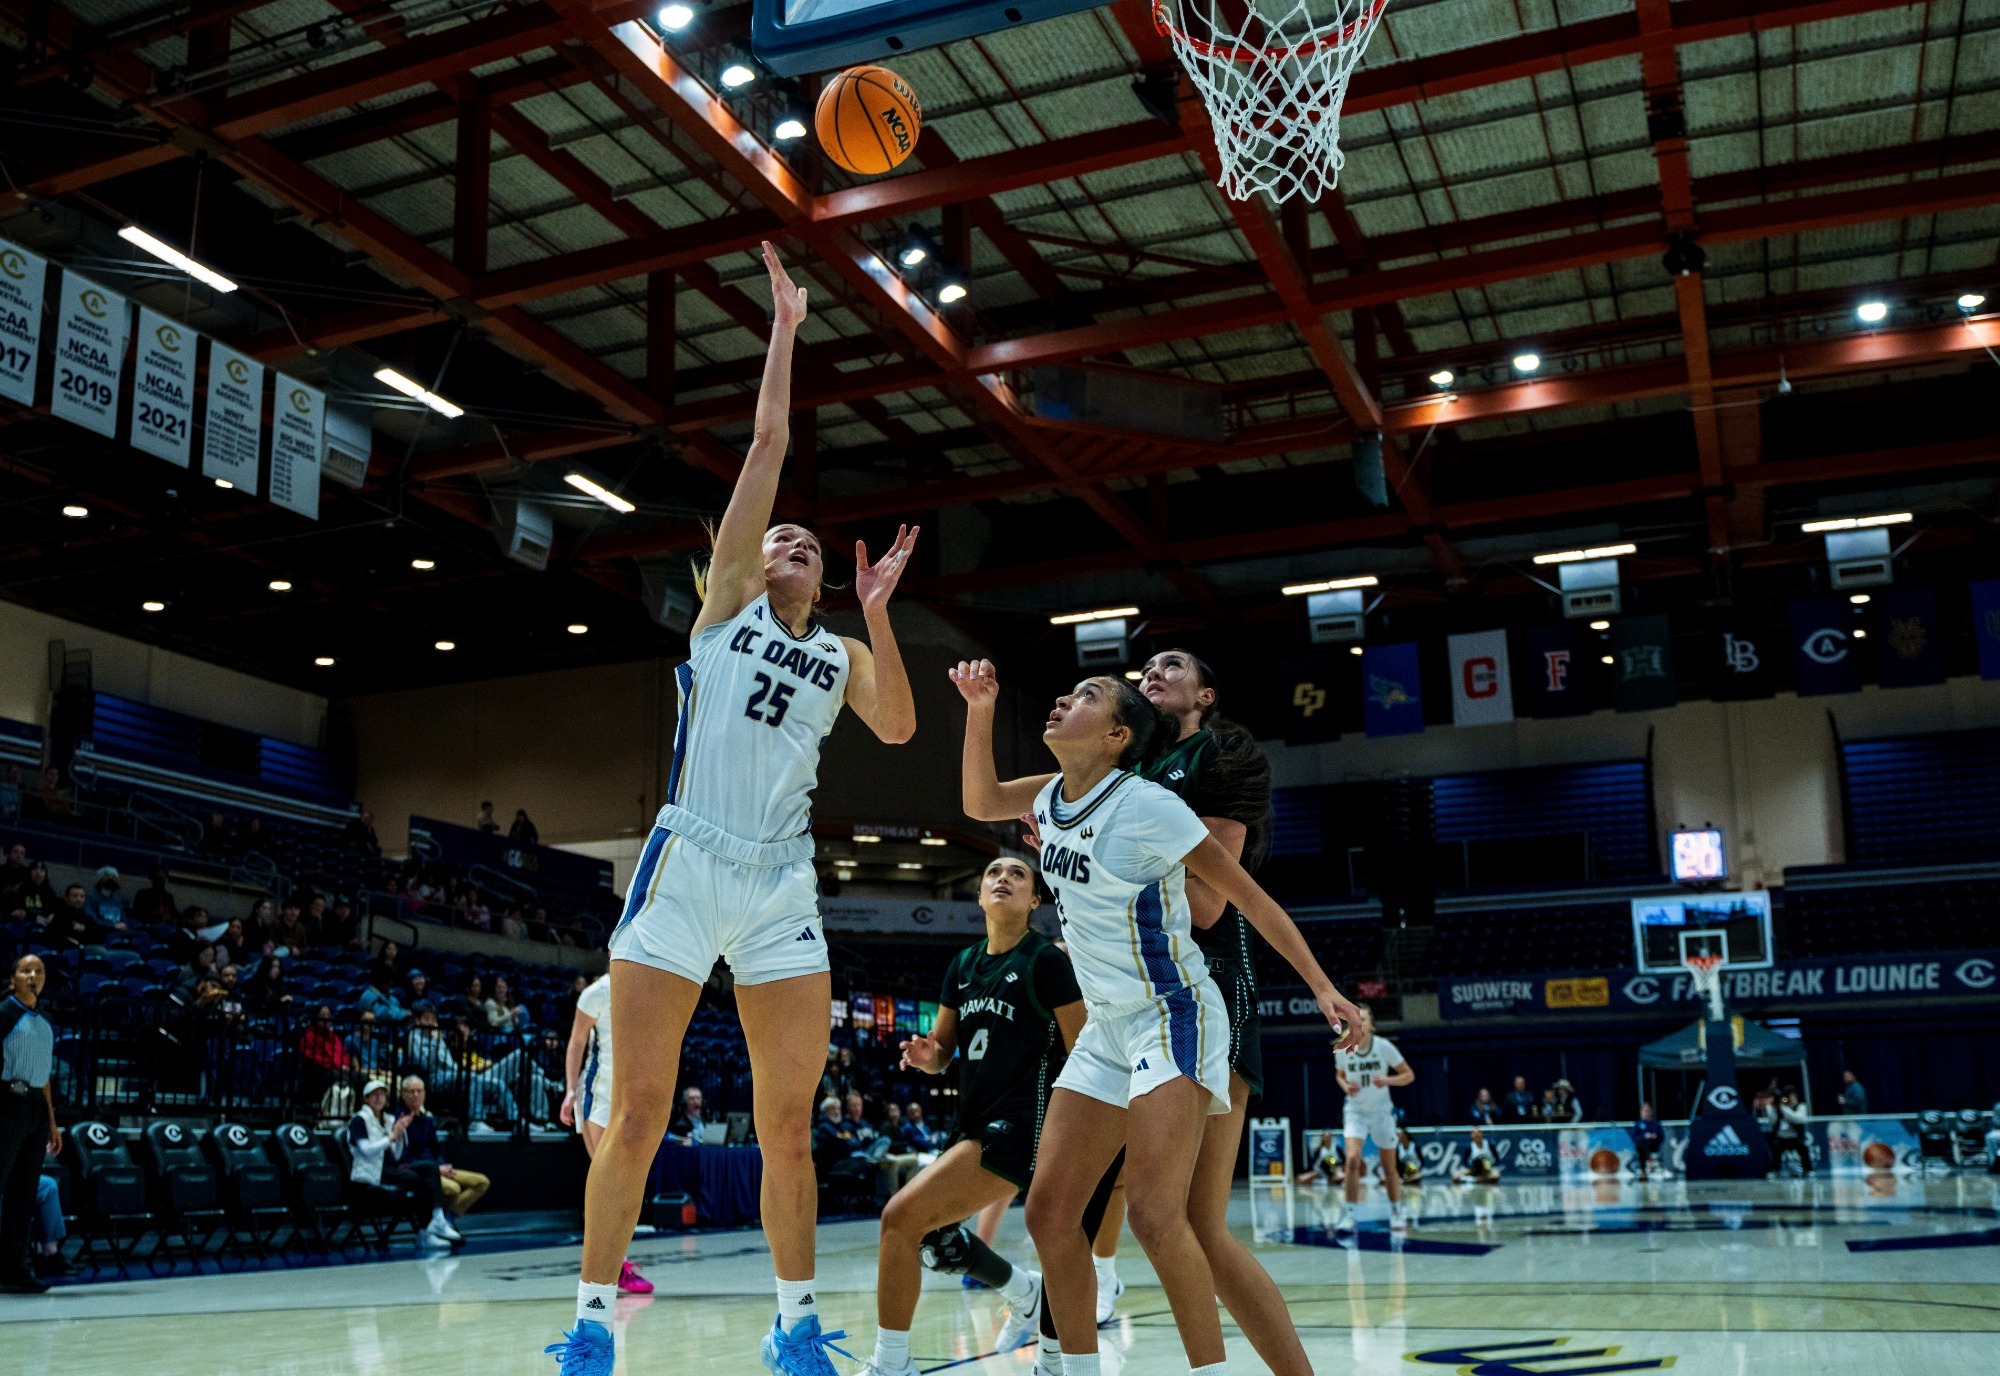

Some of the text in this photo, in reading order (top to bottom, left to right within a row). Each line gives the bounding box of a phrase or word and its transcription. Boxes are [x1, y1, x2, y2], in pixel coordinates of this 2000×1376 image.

[882, 107, 910, 155] NCAA
[68, 320, 112, 347] BASKETBALL
[59, 348, 117, 379] TOURNAMENT
[69, 338, 109, 366] NCAA
[144, 356, 186, 381] BASKETBALL
[60, 369, 112, 406] 2019
[137, 382, 190, 411] TOURNAMENT
[145, 372, 183, 399] NCAA
[139, 402, 186, 438] 2021
[761, 638, 841, 693] DAVIS
[1543, 649, 1571, 691] F
[744, 670, 798, 728] 25
[1042, 843, 1091, 884] DAVIS
[1450, 980, 1534, 1005] SUDWERK
[1671, 966, 1824, 1000] FATBREAK
[1835, 961, 1941, 994] LOUNGE
[1361, 1074, 1370, 1088] 11
[1518, 1138, 1547, 1154] GO
[1703, 1144, 1750, 1157] adidas
